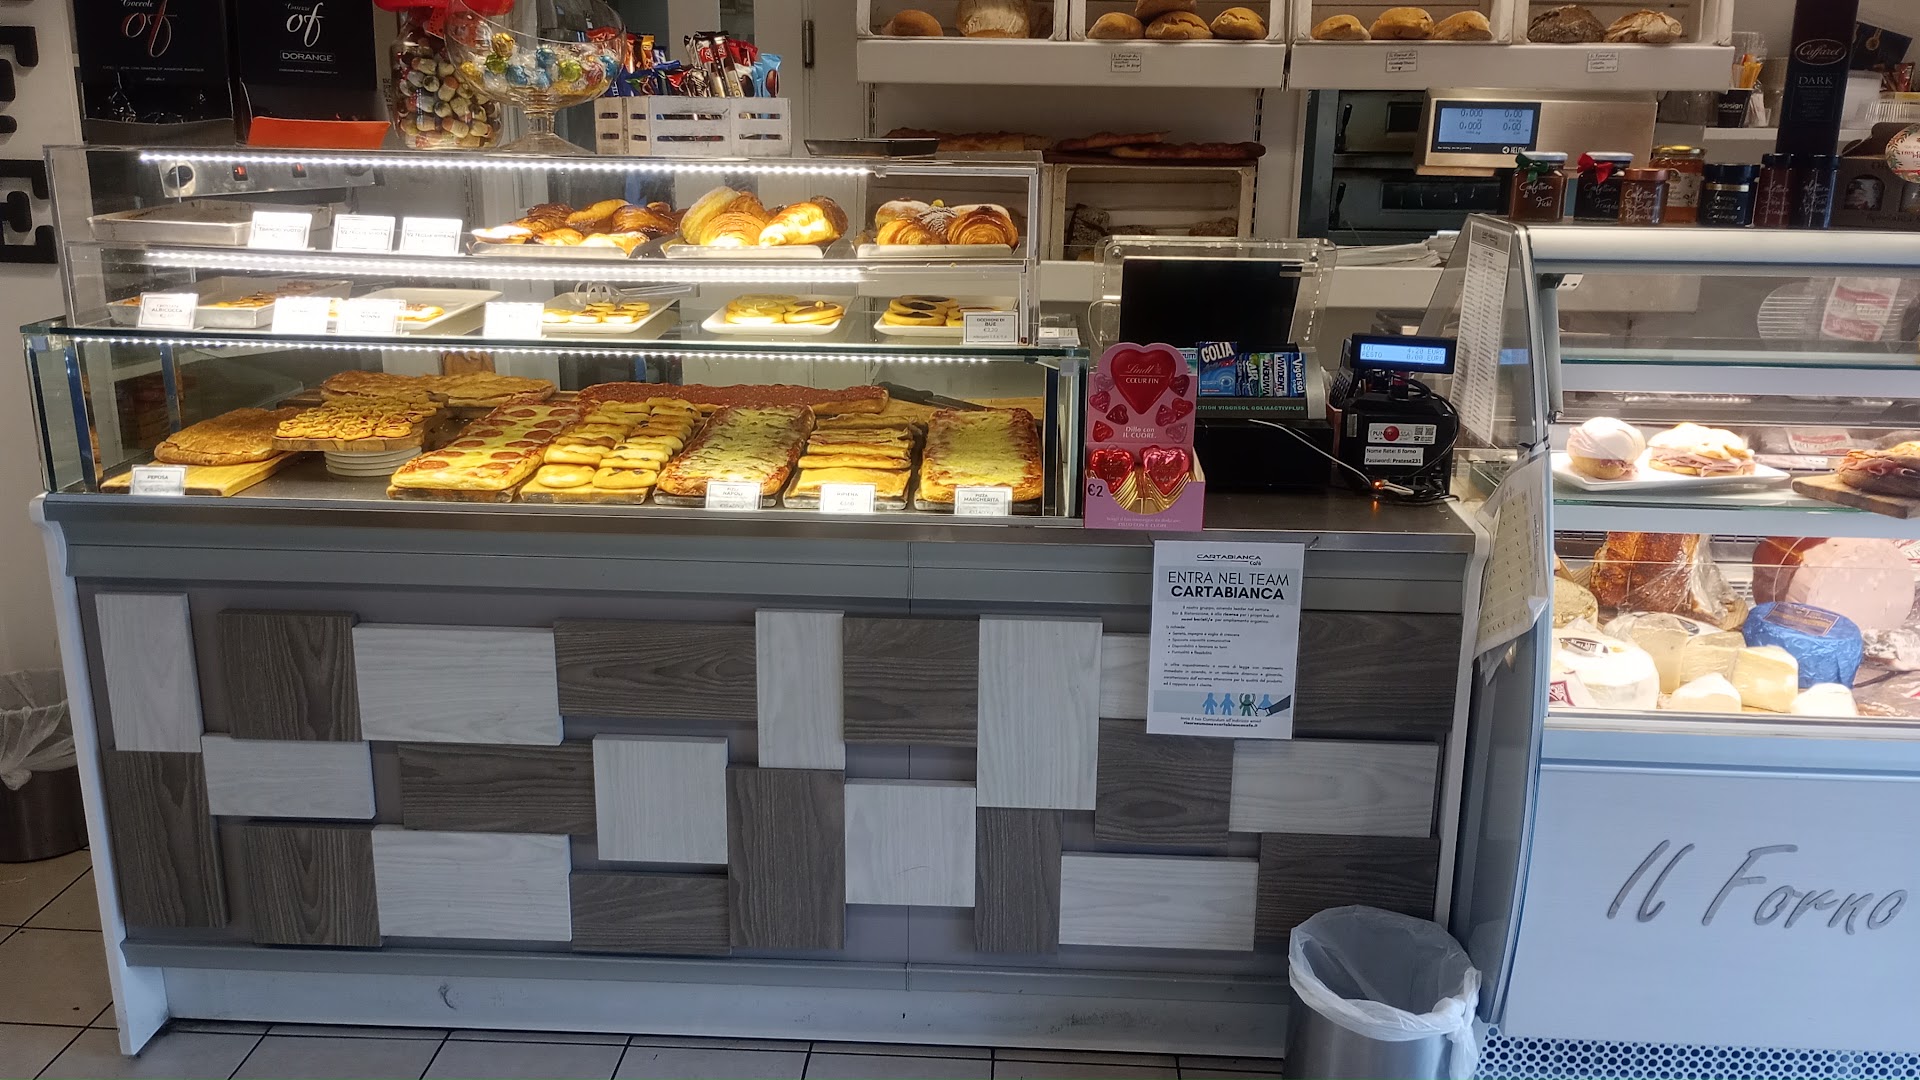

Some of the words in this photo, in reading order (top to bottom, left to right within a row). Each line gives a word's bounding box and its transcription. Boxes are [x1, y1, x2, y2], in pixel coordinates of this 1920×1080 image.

[282, 52, 333, 62] DORANGE
[1800, 44, 1843, 60] Caffarel
[1798, 76, 1833, 85] DARK
[1201, 342, 1235, 363] GOLIA
[1126, 363, 1155, 374] Lindt
[1277, 353, 1286, 392] VIVIDENT
[1292, 353, 1306, 394] Vigorsol
[1087, 483, 1104, 498] €2
[1168, 571, 1214, 584] ENTRA
[1219, 572, 1245, 585] NEL
[1249, 573, 1289, 586] TEAM
[1171, 585, 1285, 600] CARTABIANCA
[1606, 839, 1695, 923] Il
[1701, 844, 1909, 936] Forno
